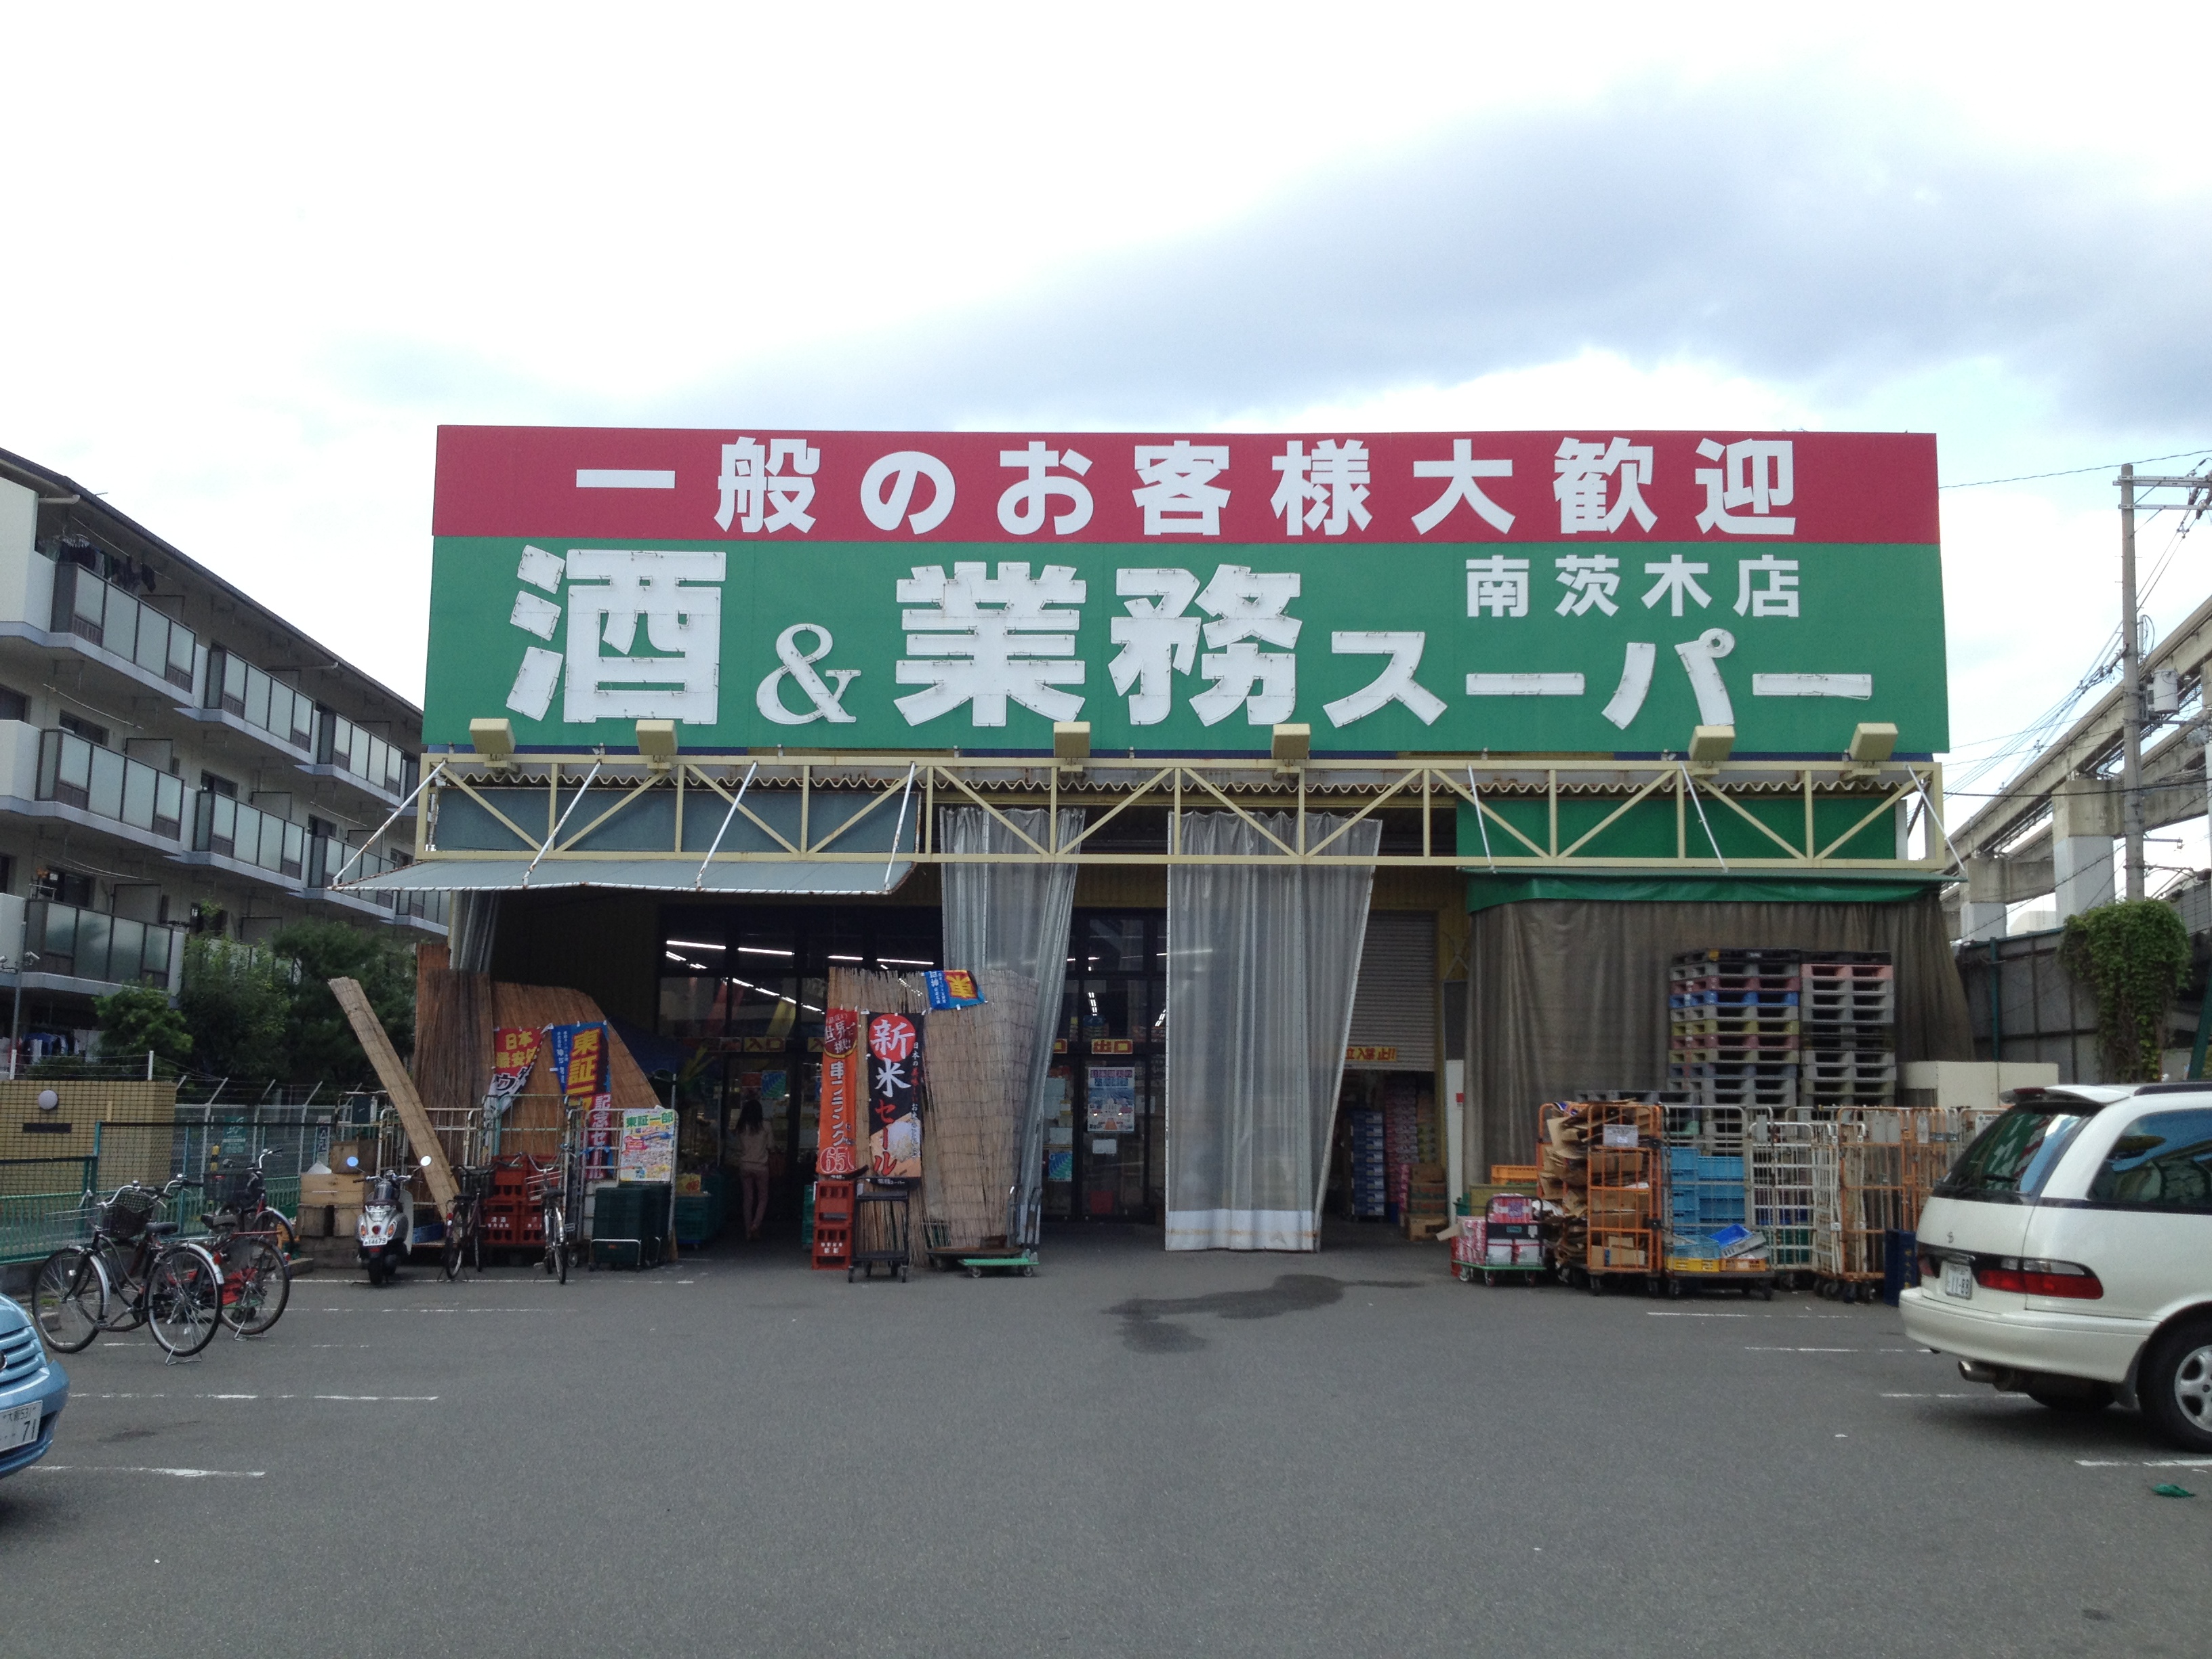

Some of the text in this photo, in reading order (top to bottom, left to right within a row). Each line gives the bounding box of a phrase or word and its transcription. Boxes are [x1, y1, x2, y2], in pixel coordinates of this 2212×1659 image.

[575, 436, 1797, 536] 一般のお客様大歓迎
[1465, 554, 1800, 618] 南茨木店
[505, 544, 1872, 731] 酒&業務スーパー
[506, 1031, 533, 1050] 日本
[747, 1039, 784, 1051] 入口
[1092, 1040, 1132, 1053] 出口
[870, 1019, 916, 1176] 新米セール
